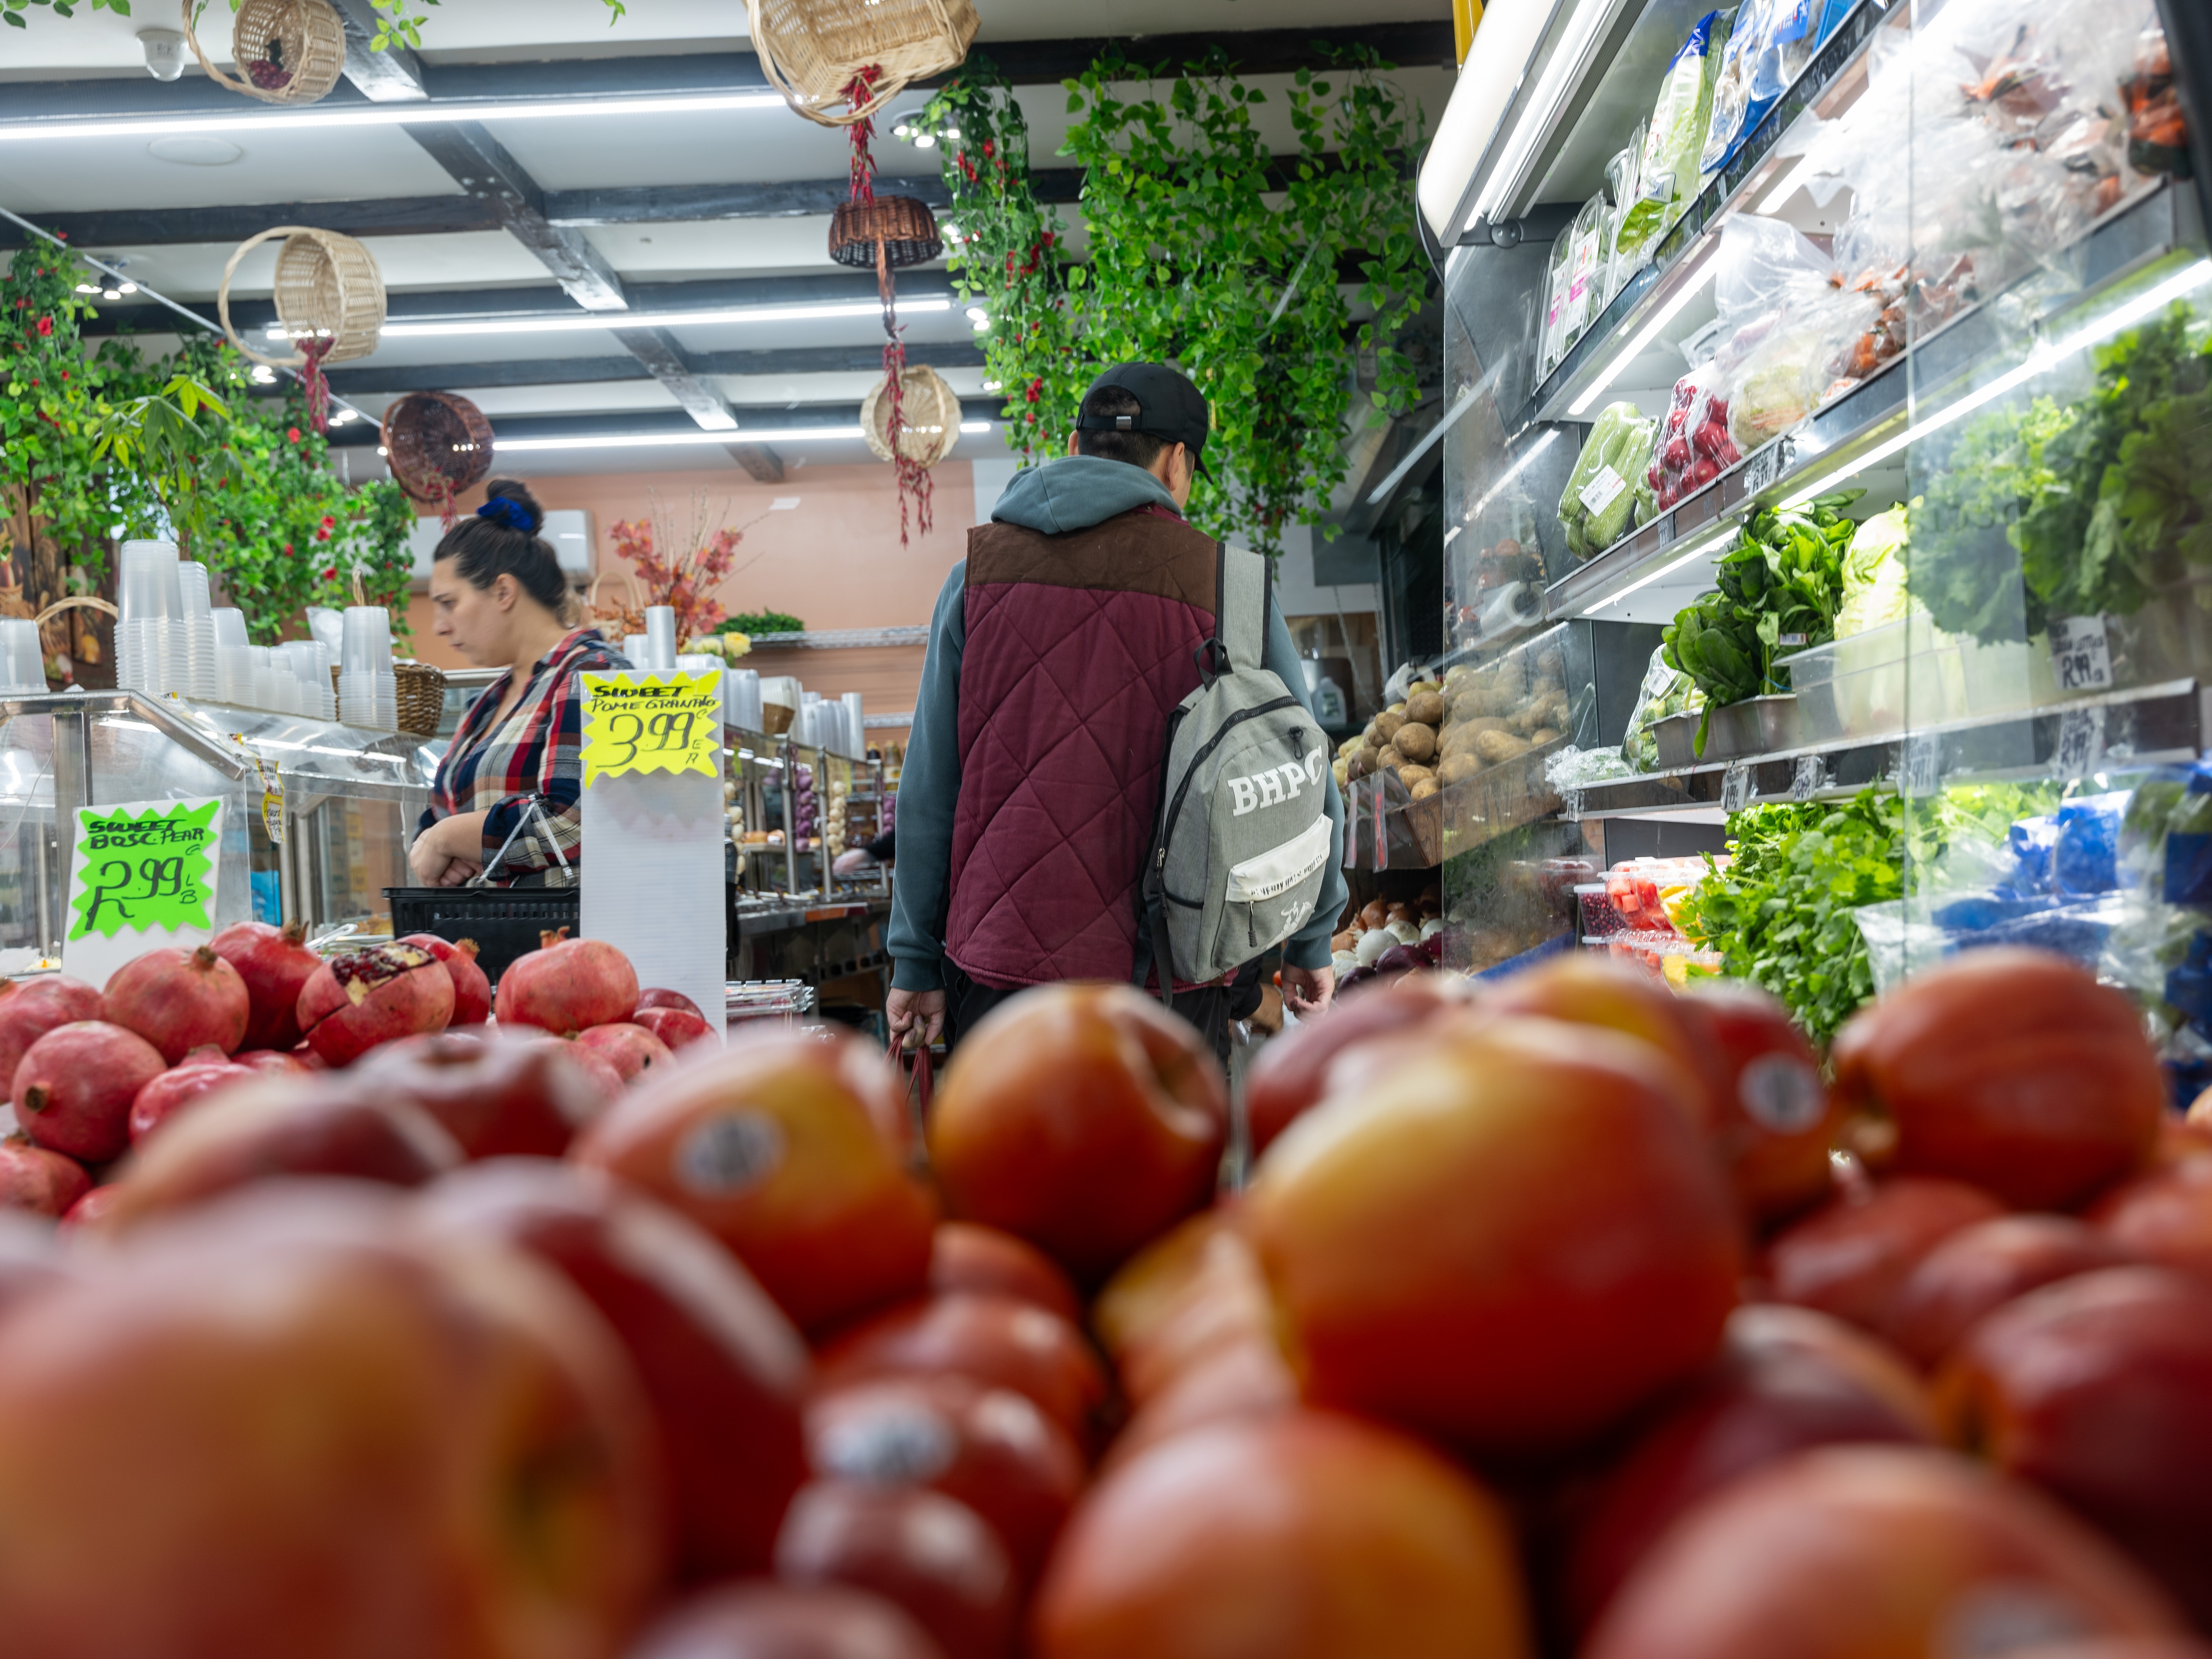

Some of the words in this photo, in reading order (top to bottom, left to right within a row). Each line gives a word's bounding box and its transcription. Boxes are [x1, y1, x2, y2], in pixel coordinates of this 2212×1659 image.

[593, 685, 693, 698] SWEET
[1227, 745, 1322, 817] BHPC
[88, 819, 187, 833] SWEET
[160, 828, 204, 844] PEAR
